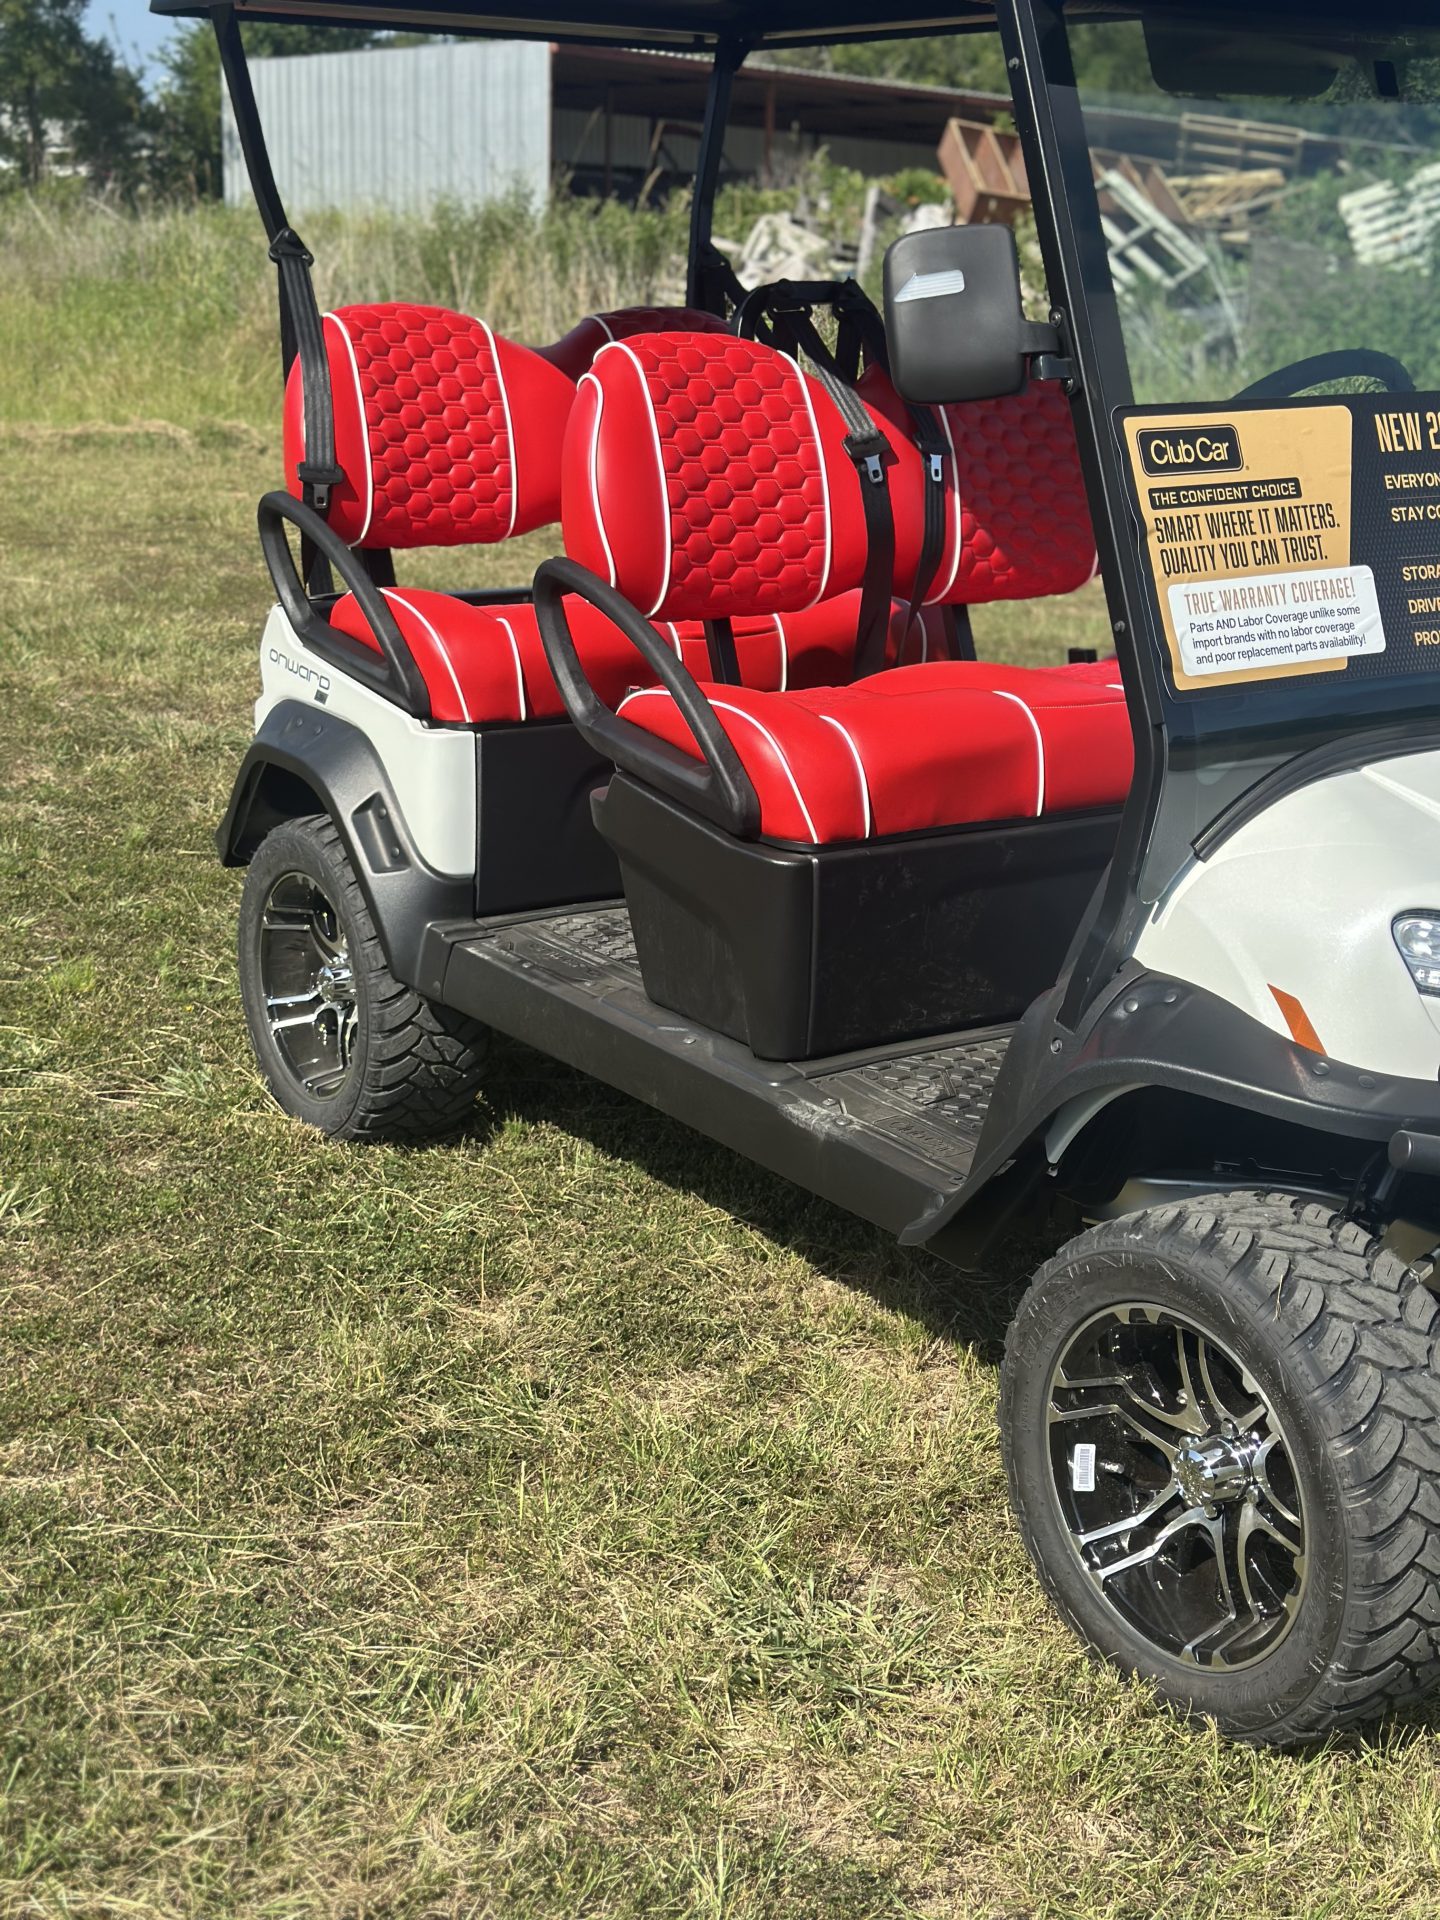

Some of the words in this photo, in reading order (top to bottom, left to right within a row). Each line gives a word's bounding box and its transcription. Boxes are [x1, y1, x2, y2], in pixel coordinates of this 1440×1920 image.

[1374, 412, 1422, 453] NEW
[1150, 438, 1195, 465] Club
[1195, 437, 1229, 462] Car
[1152, 491, 1178, 506] THE
[1179, 486, 1248, 504] CONFIDENT
[1251, 482, 1297, 498] CHOICE
[1154, 513, 1203, 544] SMART
[1205, 509, 1256, 539] WHERE
[1257, 508, 1271, 535] IT
[1274, 502, 1341, 534] MATTERS.
[1391, 505, 1424, 522] STAY
[1159, 543, 1217, 578] QUALITY
[1219, 540, 1249, 570] YOU
[1251, 538, 1281, 566] CAN
[1281, 534, 1329, 564] TRUST.
[1184, 591, 1218, 616] TRUE
[1218, 583, 1287, 612] WARRANTY
[1291, 576, 1357, 604] COVERAGE!
[1189, 621, 1215, 634] Parts
[1216, 617, 1237, 631] AND
[1237, 615, 1264, 628] Labor
[1265, 610, 1309, 624] Coverage
[1309, 607, 1336, 620] unlike
[1337, 605, 1361, 617] some
[1192, 635, 1224, 651] import
[1224, 631, 1256, 646] brands
[1257, 628, 1277, 641] with
[1278, 629, 1290, 639] no
[1291, 625, 1313, 638] labor
[1314, 621, 1356, 635] coverage
[1196, 652, 1215, 665] and
[1215, 651, 1238, 666] poor
[1237, 642, 1294, 662] replacement
[1294, 640, 1318, 656] parts
[1319, 632, 1367, 650] availability!
[1414, 629, 1440, 647] PRO
